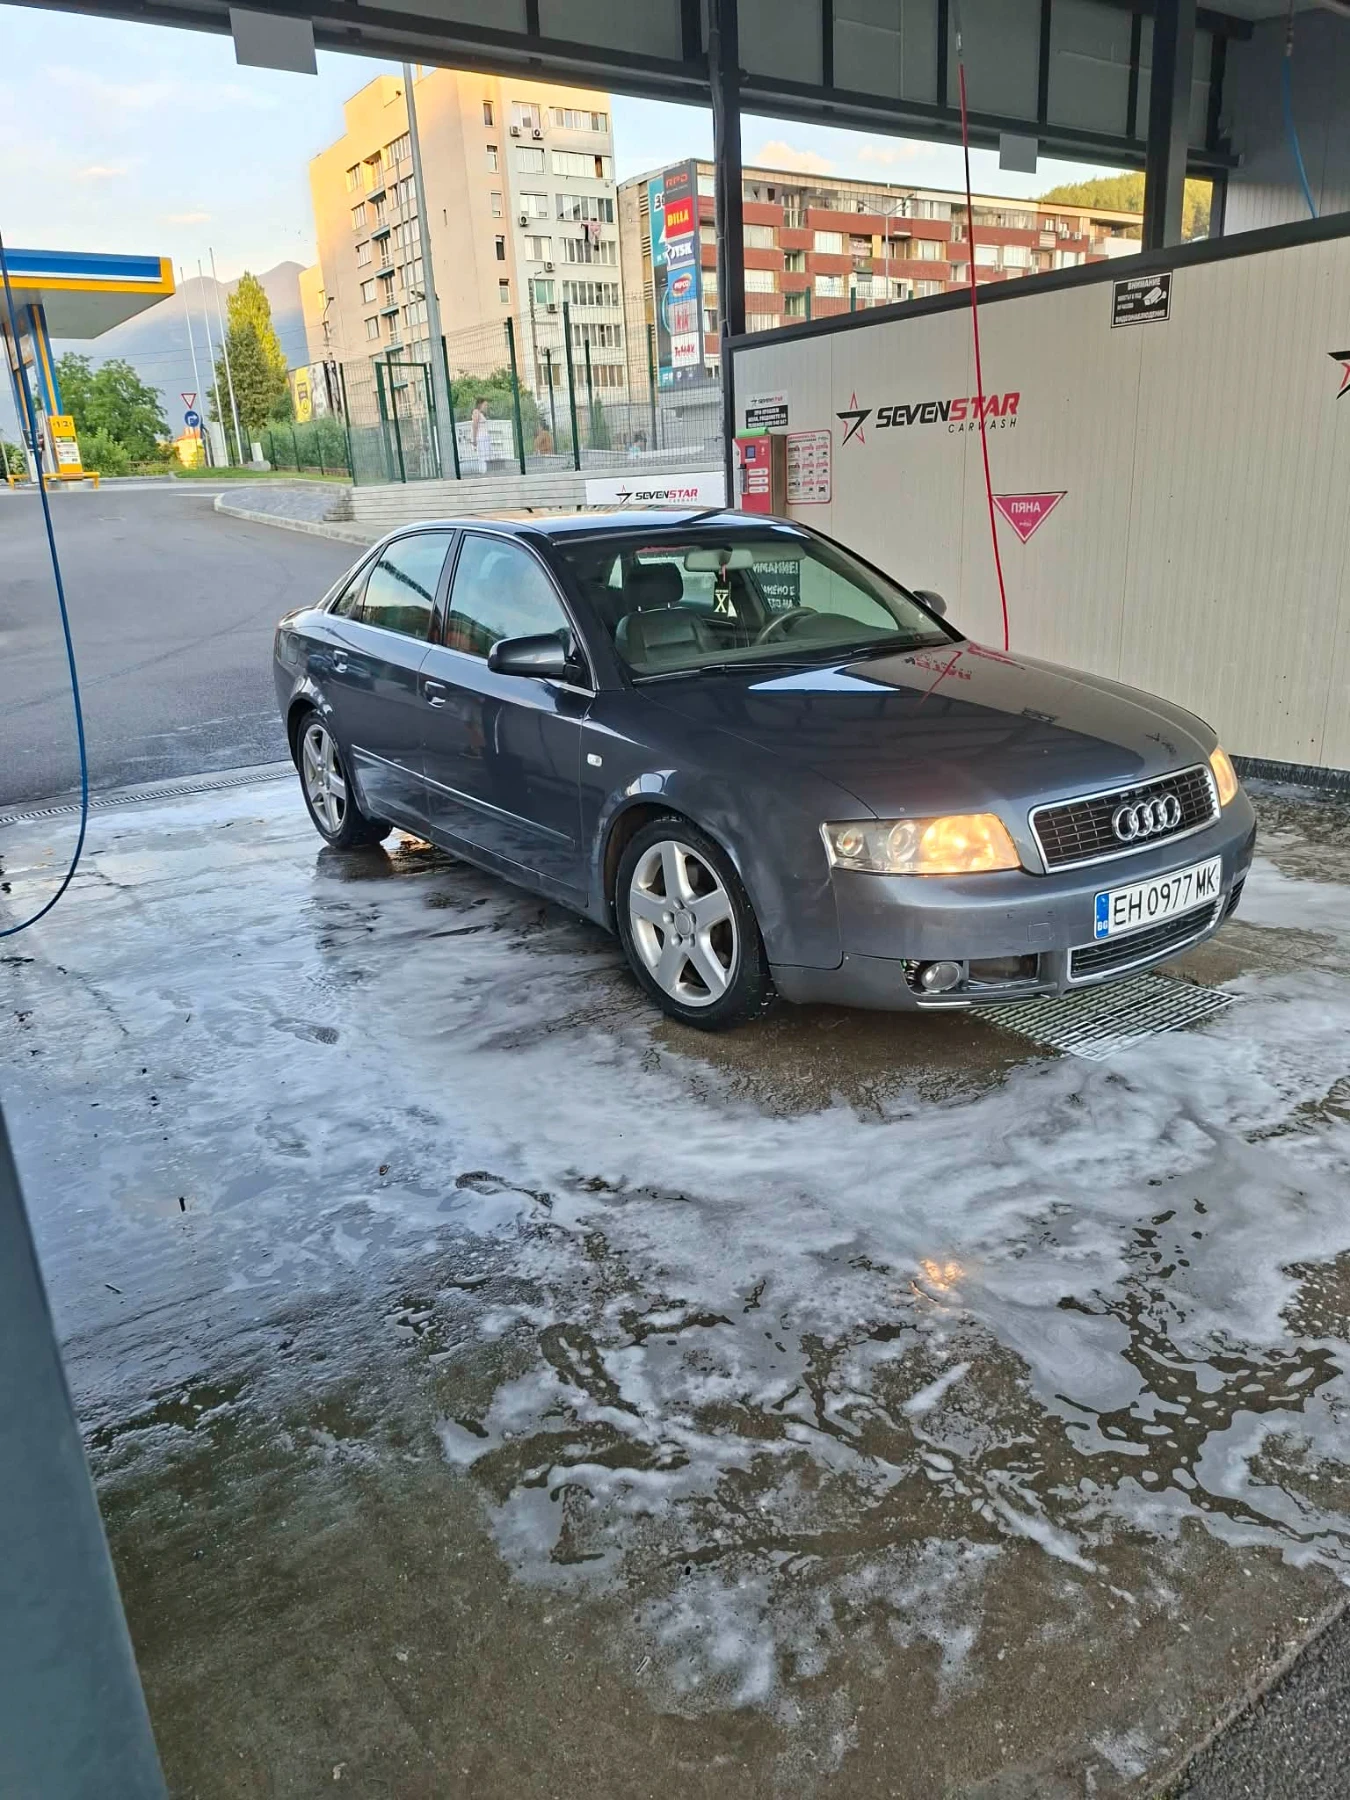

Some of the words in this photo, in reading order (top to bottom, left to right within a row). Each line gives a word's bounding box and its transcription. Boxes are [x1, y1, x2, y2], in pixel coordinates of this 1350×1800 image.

[667, 209, 689, 227] BILLA
[671, 242, 692, 259] JYSK
[674, 279, 690, 289] PEPCO
[875, 392, 1020, 428] SEVENSTAR
[635, 488, 698, 500] SEVENSTAR
[1011, 502, 1041, 513] ПЯНА
[713, 593, 729, 613] X
[1114, 890, 1142, 925] EH
[1147, 873, 1193, 916] 0977
[1196, 864, 1218, 900] MK
[1097, 920, 1108, 931] BG
